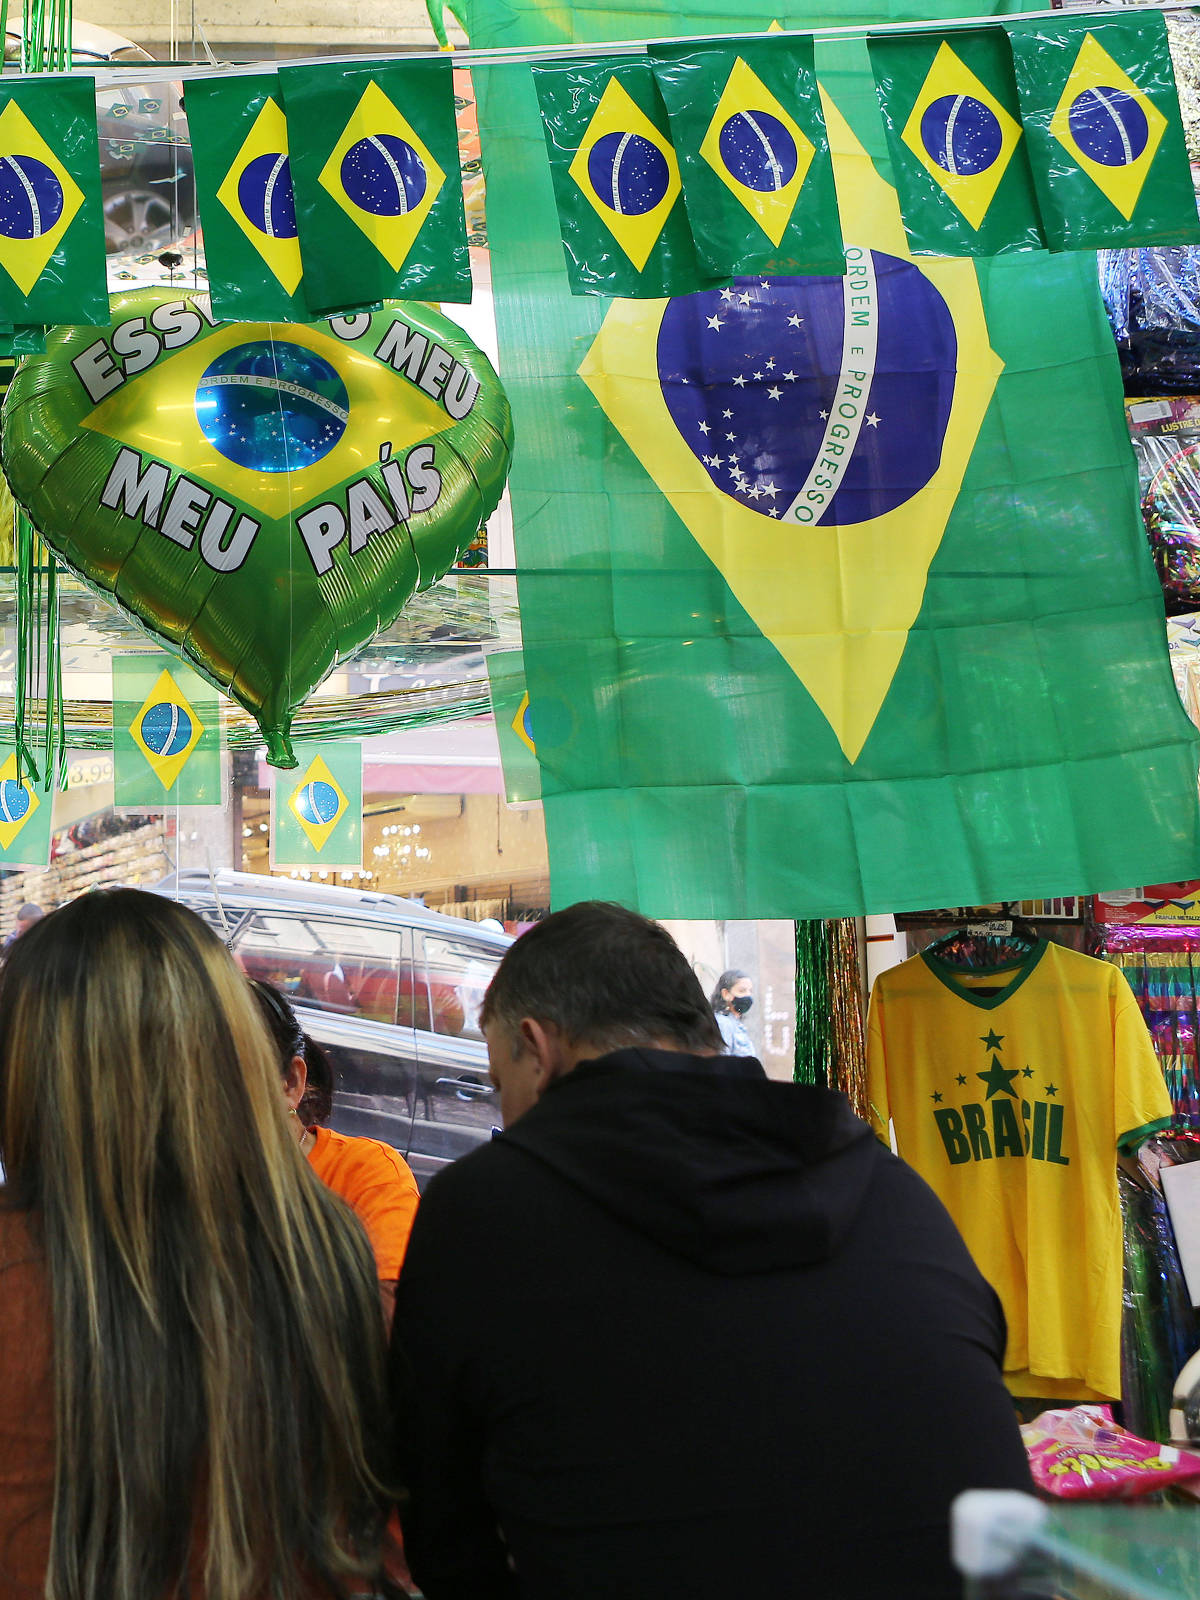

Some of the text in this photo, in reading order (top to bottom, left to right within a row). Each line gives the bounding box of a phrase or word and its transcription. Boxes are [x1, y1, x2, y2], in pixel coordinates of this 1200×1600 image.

[199, 375, 349, 421] ORDEM E PROGRESSO
[374, 320, 481, 422] MEU
[795, 247, 871, 523] ORDEM E PROGRESSO
[1161, 419, 1193, 432] LUSTRE
[100, 441, 443, 577] MEU PAÍS
[933, 1098, 1070, 1166] BRASIL
